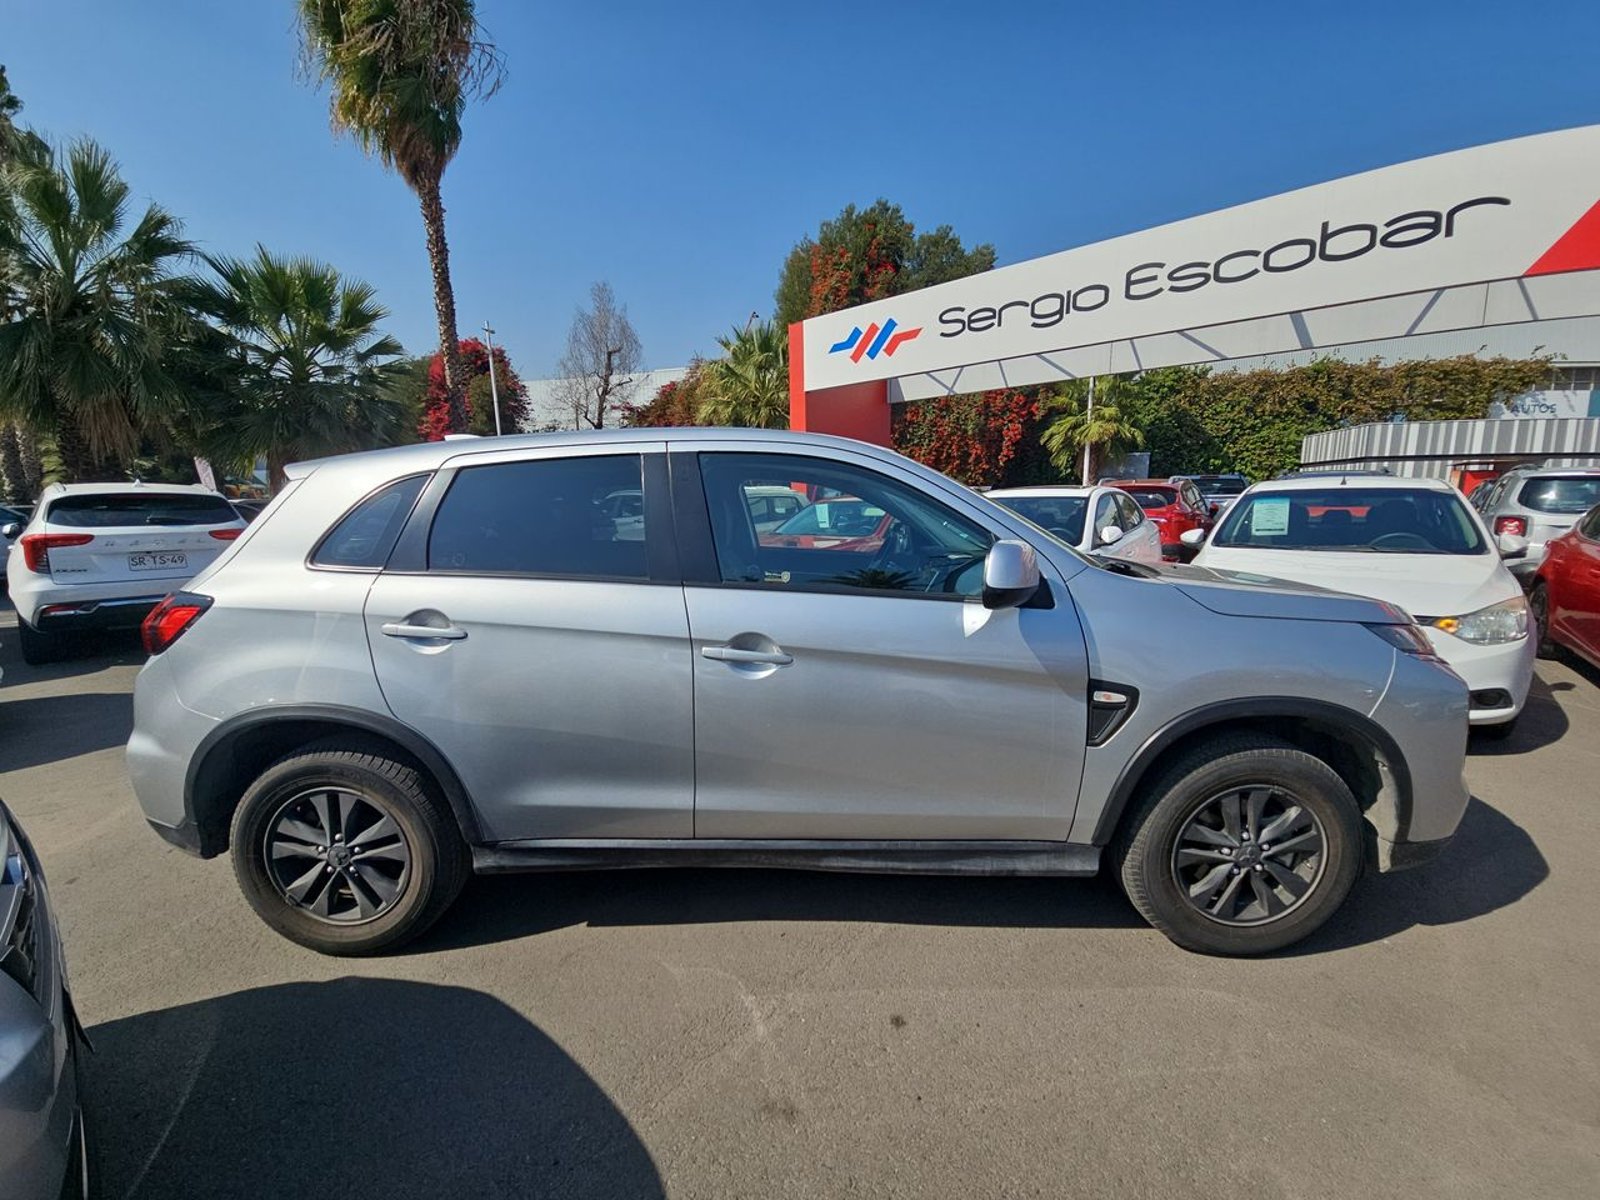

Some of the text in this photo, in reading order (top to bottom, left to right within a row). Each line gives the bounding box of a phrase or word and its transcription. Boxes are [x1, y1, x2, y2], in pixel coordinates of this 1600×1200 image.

[938, 196, 1511, 337] Sergio Escobar
[1511, 403, 1557, 414] AUTOS
